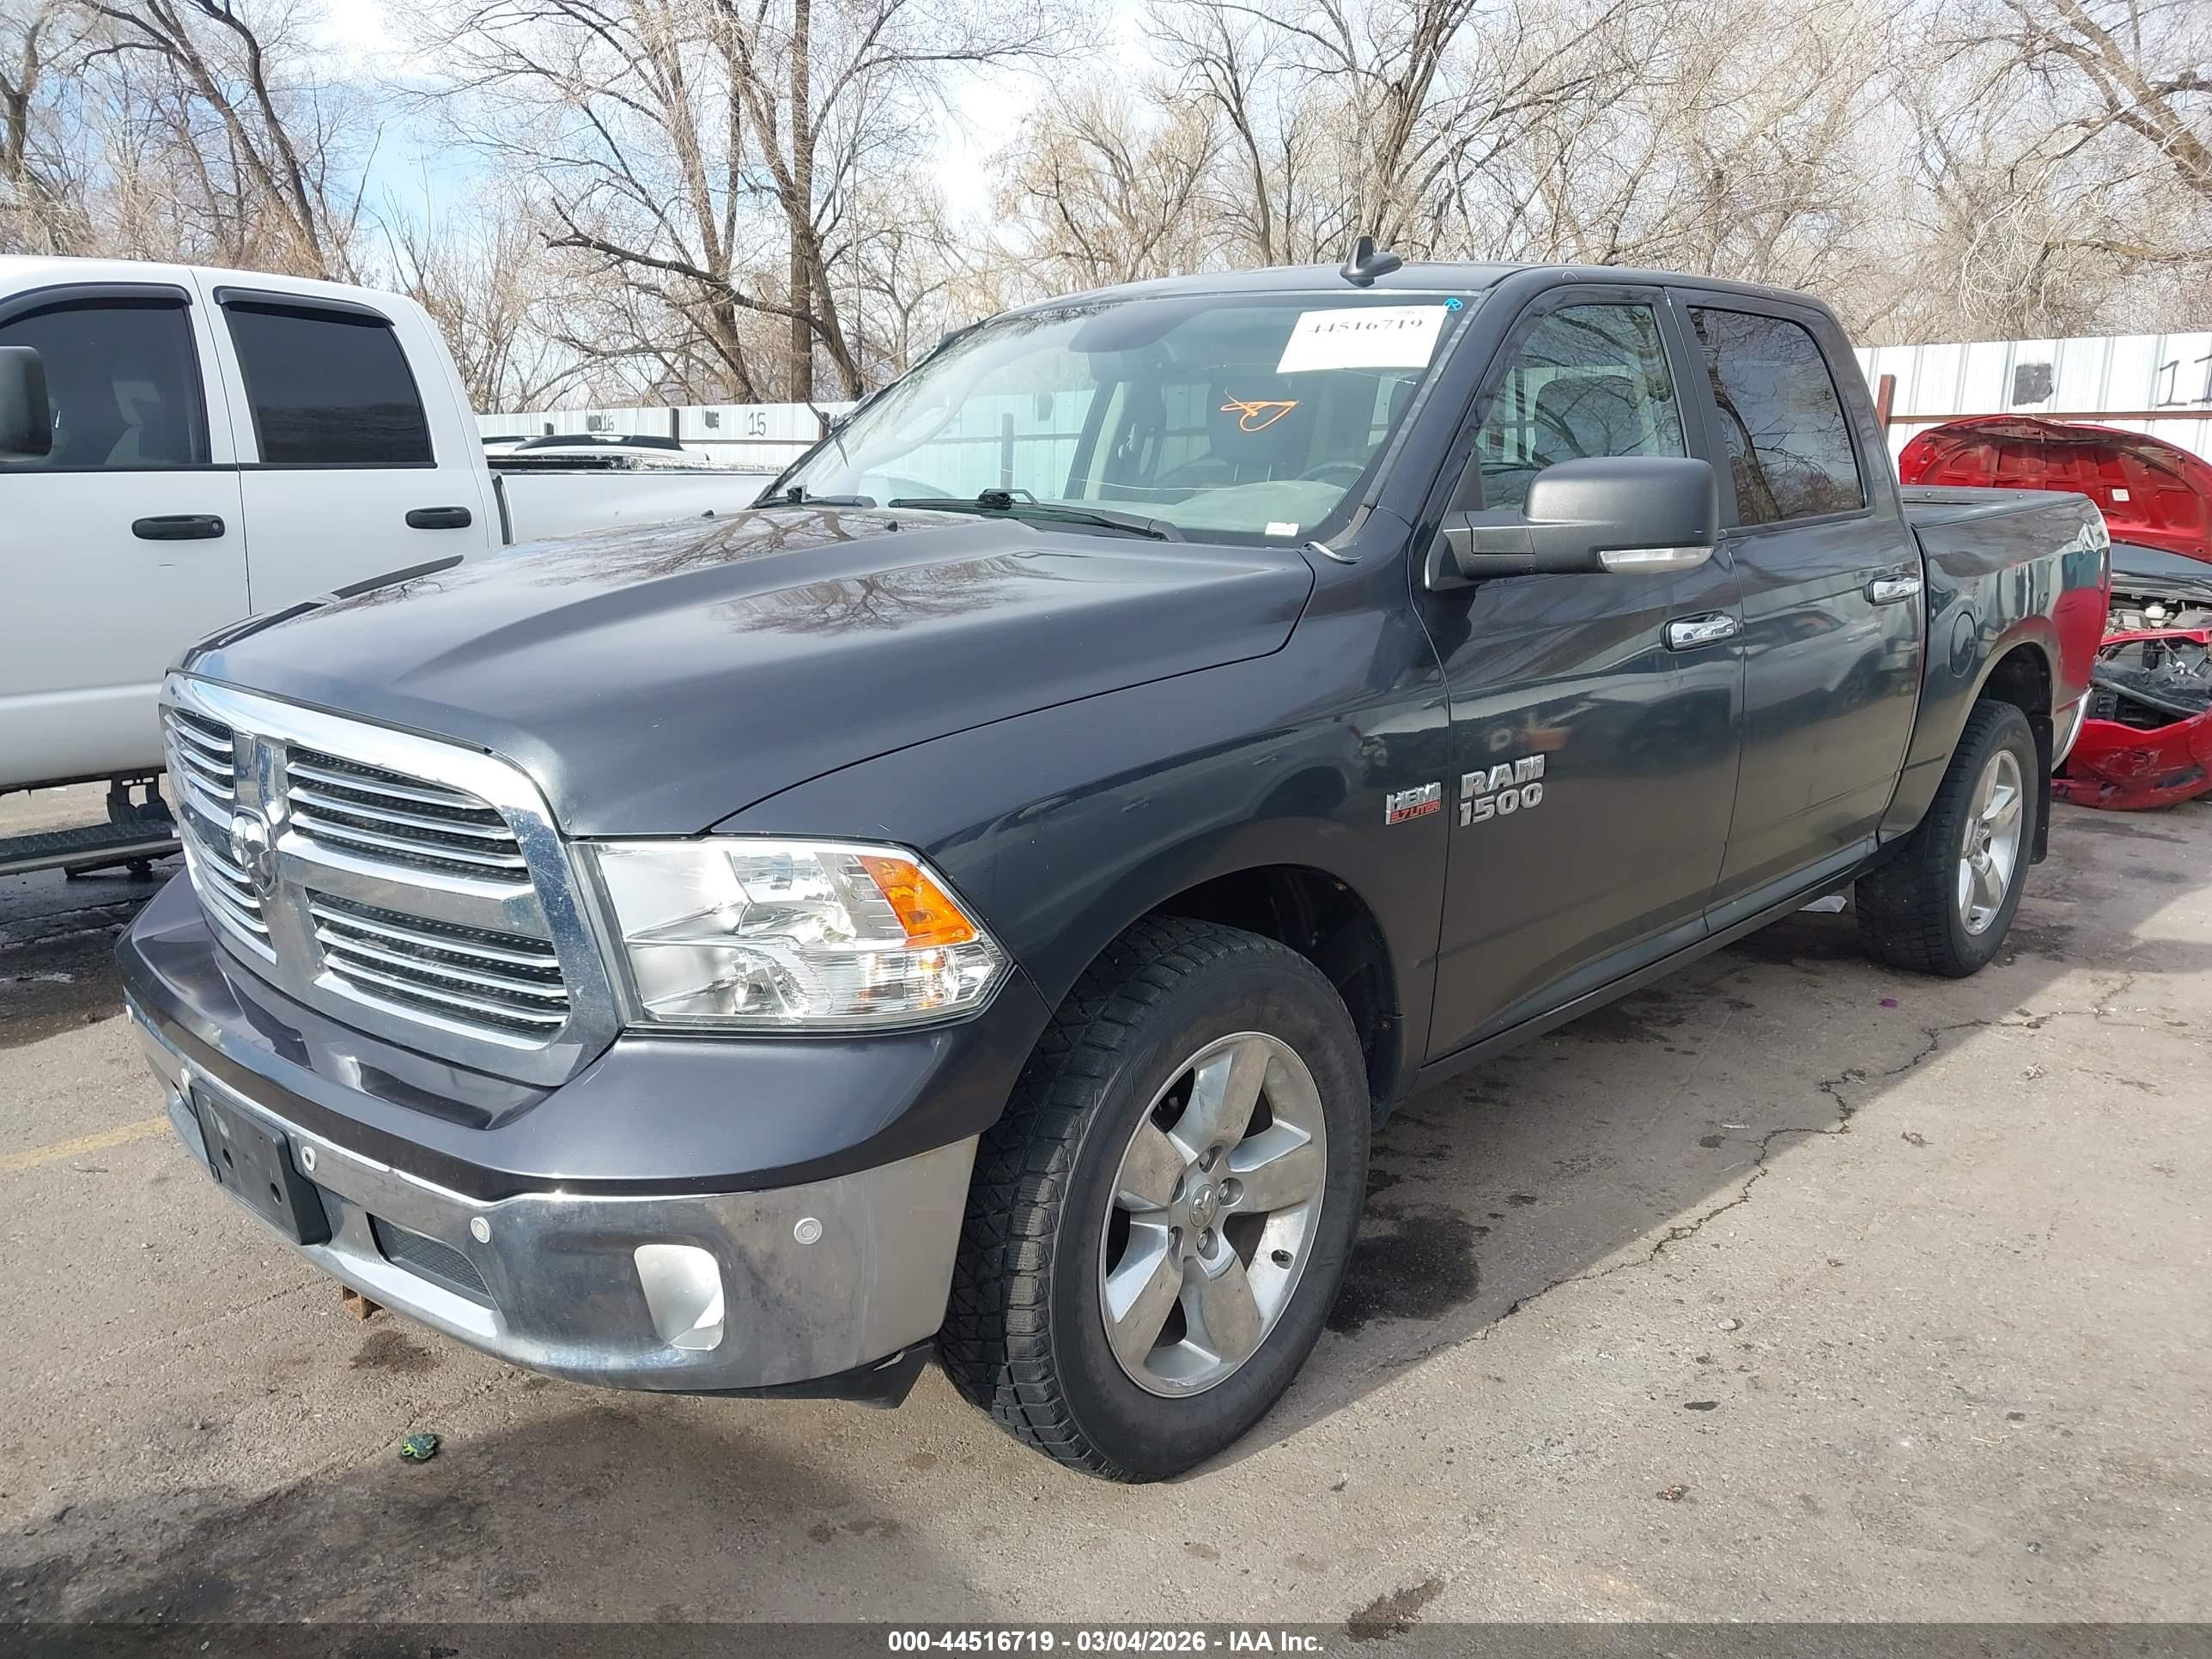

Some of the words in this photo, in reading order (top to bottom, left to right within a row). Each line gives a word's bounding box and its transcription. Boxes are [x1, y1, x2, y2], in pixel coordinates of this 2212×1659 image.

[1305, 319, 1423, 334] 44516719
[748, 411, 767, 436] 15
[1461, 754, 1545, 799] RAM
[1387, 781, 1441, 811] HEMI
[1460, 782, 1543, 827] 1500
[1390, 809, 1410, 823] 5.7
[1410, 800, 1439, 818] LITER
